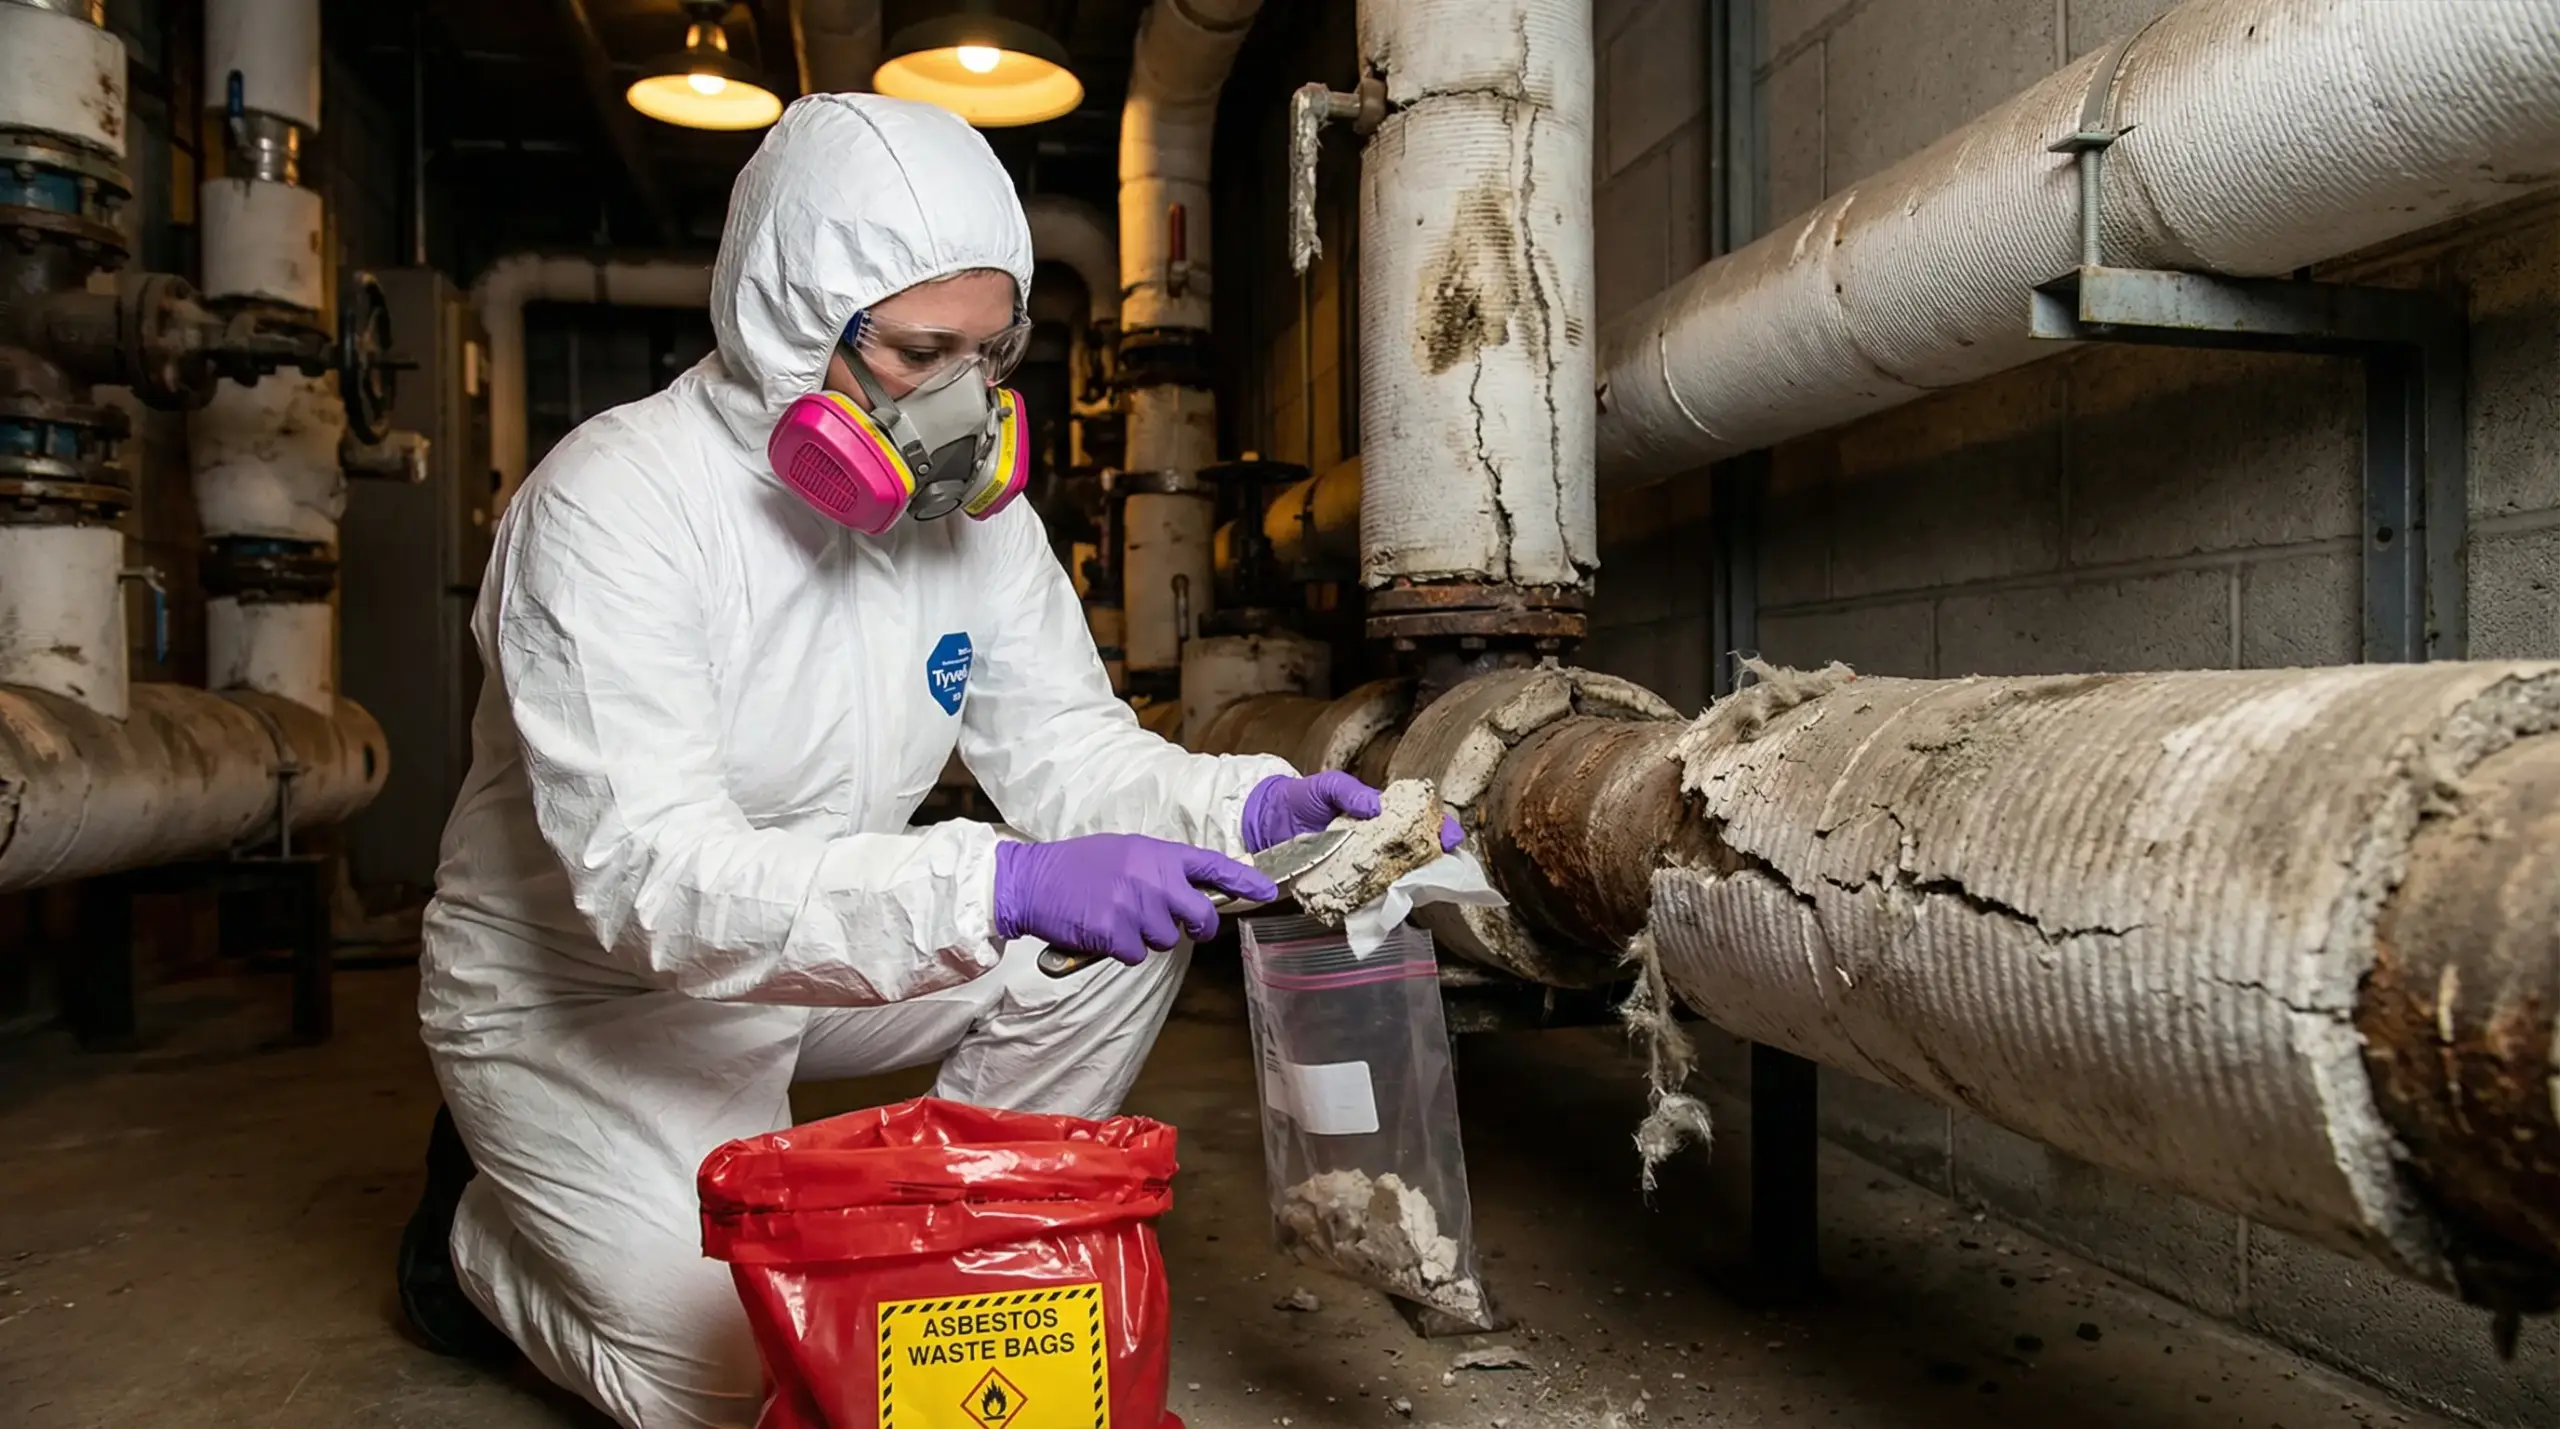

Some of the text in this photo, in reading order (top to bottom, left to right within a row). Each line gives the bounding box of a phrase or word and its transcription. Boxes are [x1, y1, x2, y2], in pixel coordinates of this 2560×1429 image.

[922, 1308, 1058, 1338] ASBESTOS
[908, 1332, 1076, 1366] WASTE BAGS
